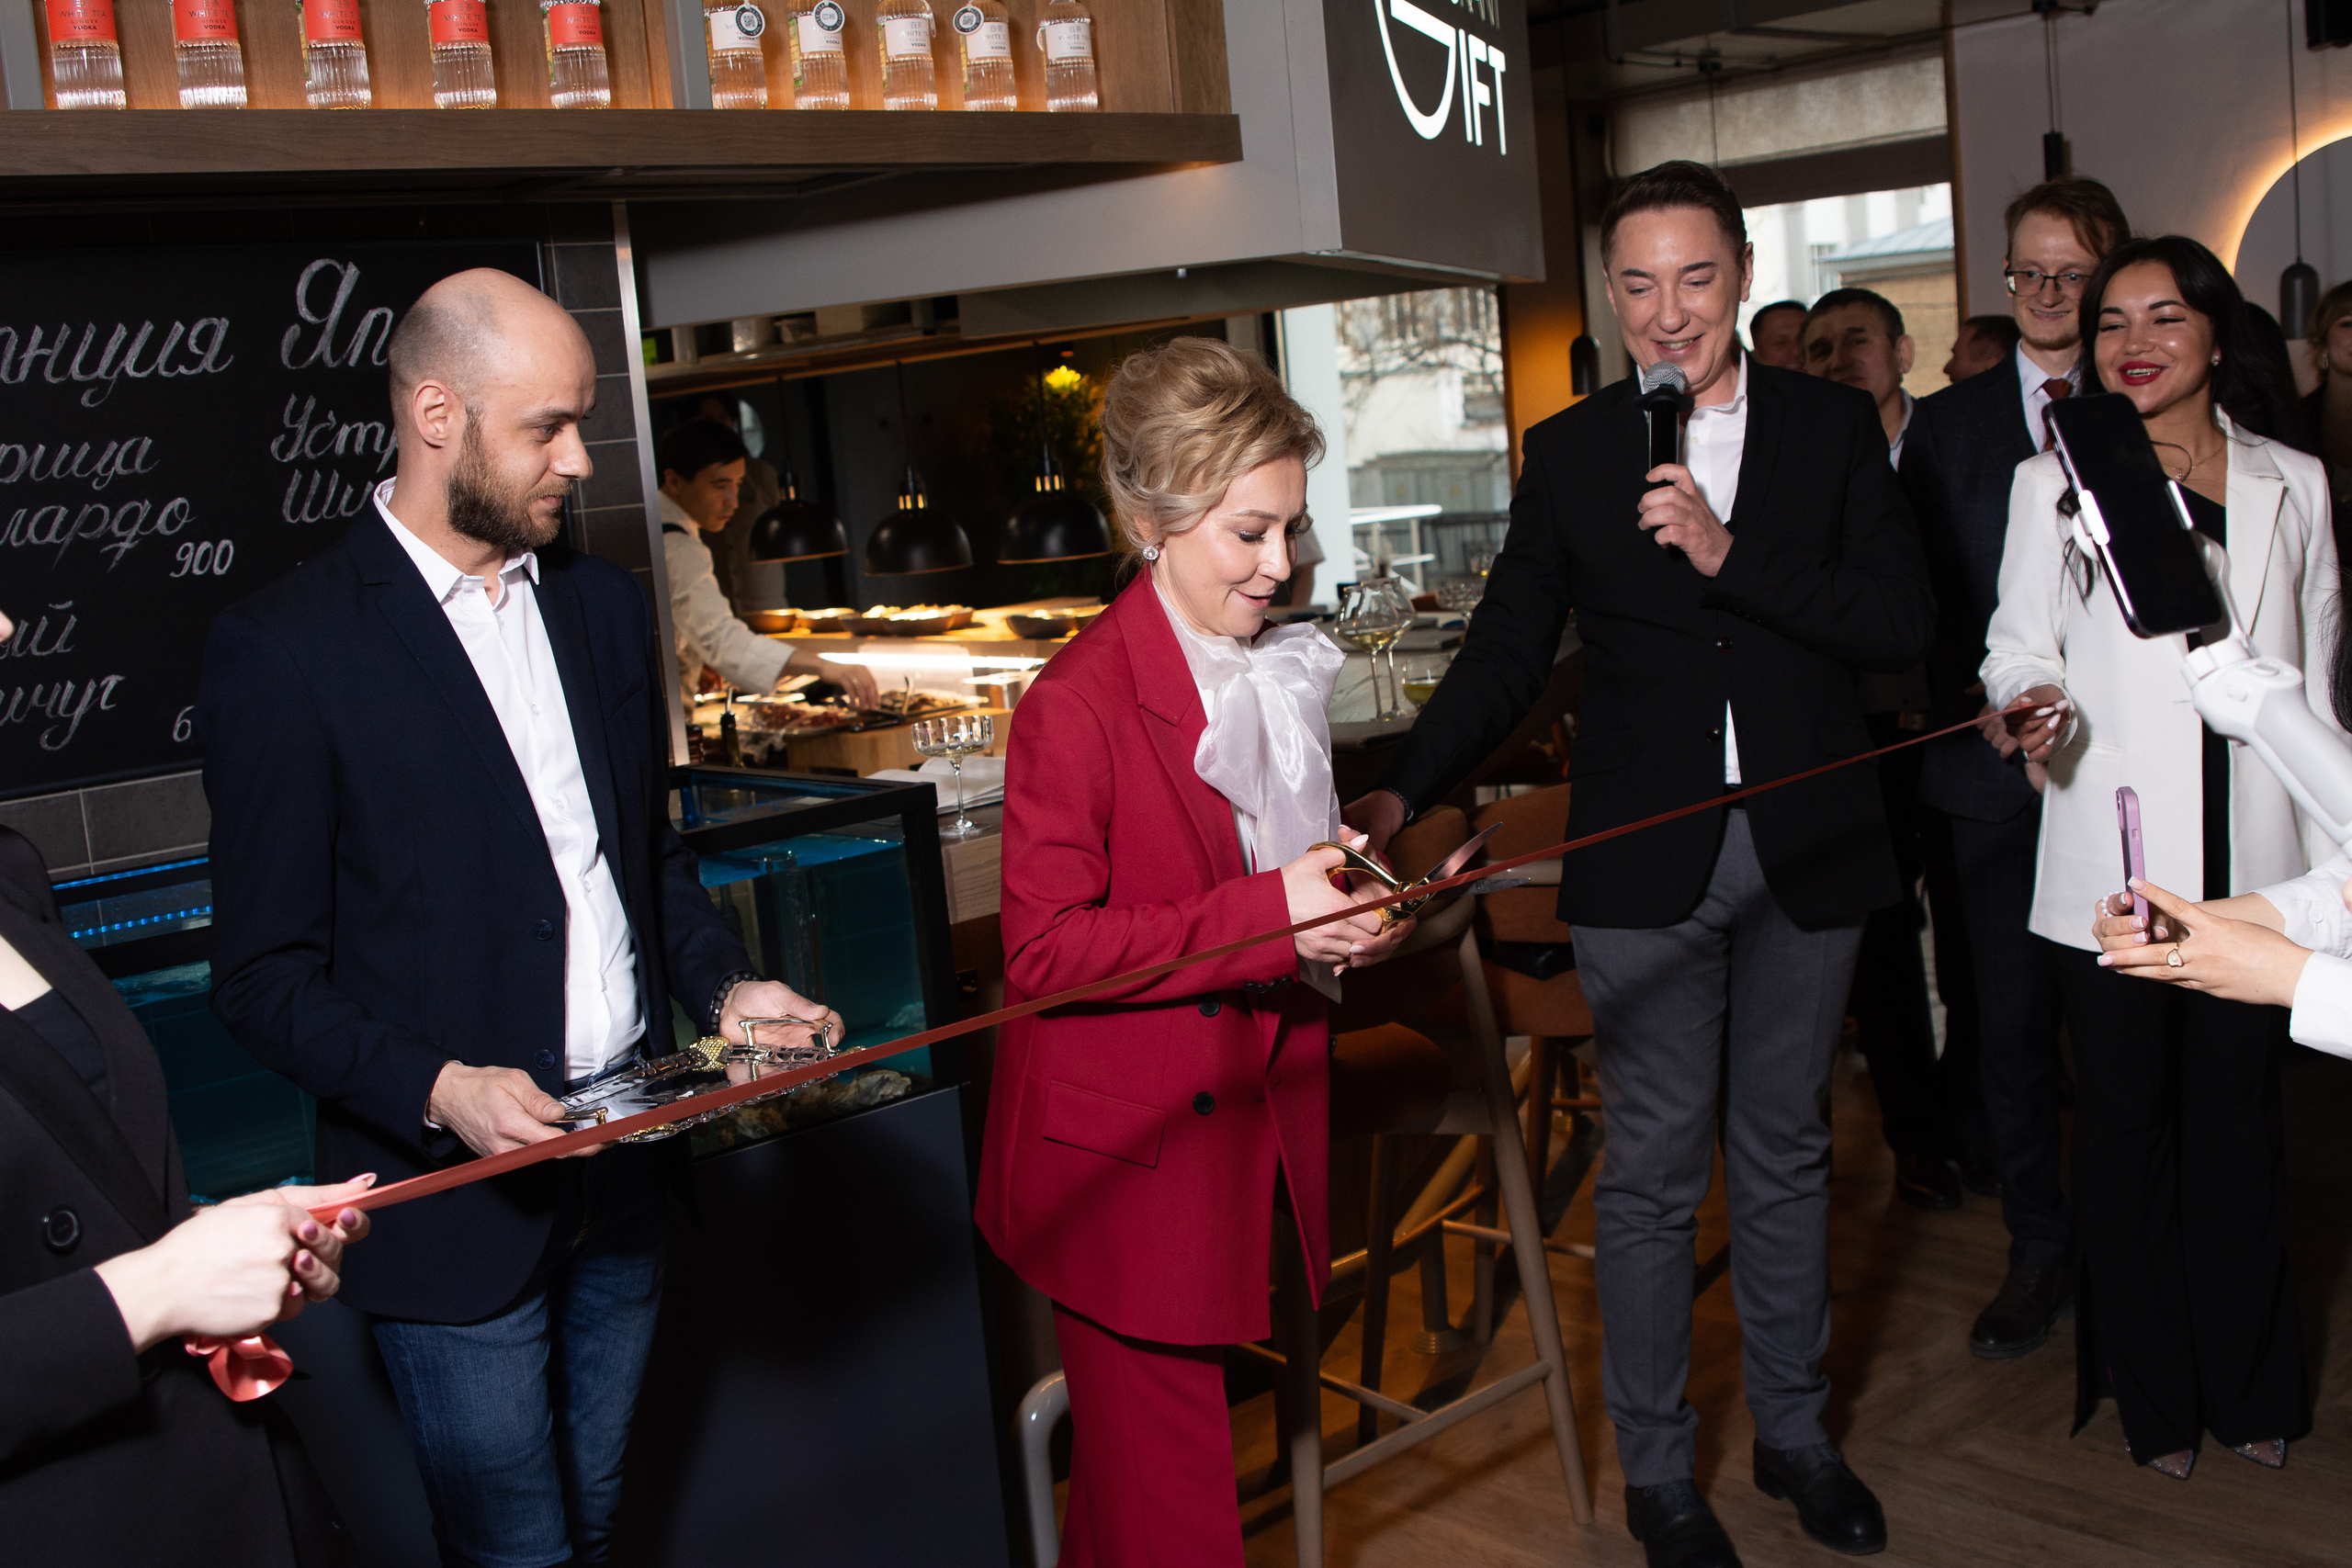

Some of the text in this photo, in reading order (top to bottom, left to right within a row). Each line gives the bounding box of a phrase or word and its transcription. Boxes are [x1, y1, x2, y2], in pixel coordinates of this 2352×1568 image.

[59, 9, 107, 17] WHITE TEA
[321, 10, 348, 18] WHITE
[280, 258, 394, 369] Яп
[169, 539, 234, 578] 900
[172, 705, 195, 743] 6
